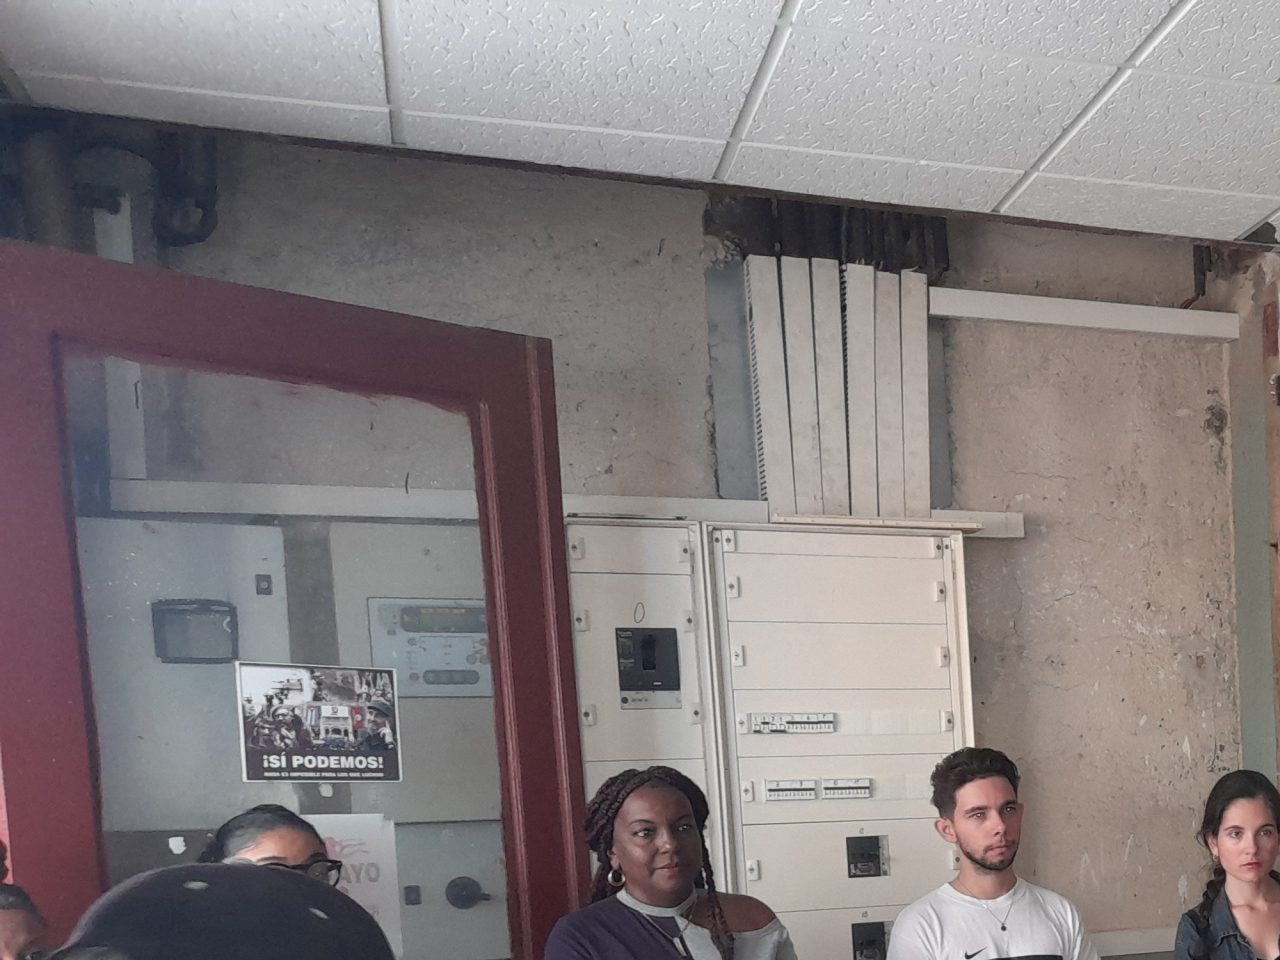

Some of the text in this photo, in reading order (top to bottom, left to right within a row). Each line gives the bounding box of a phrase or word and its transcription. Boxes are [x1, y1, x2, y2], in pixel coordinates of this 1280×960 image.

[263, 752, 384, 768] ¡SÍ PODEMOS!
[340, 862, 380, 883] AYO
